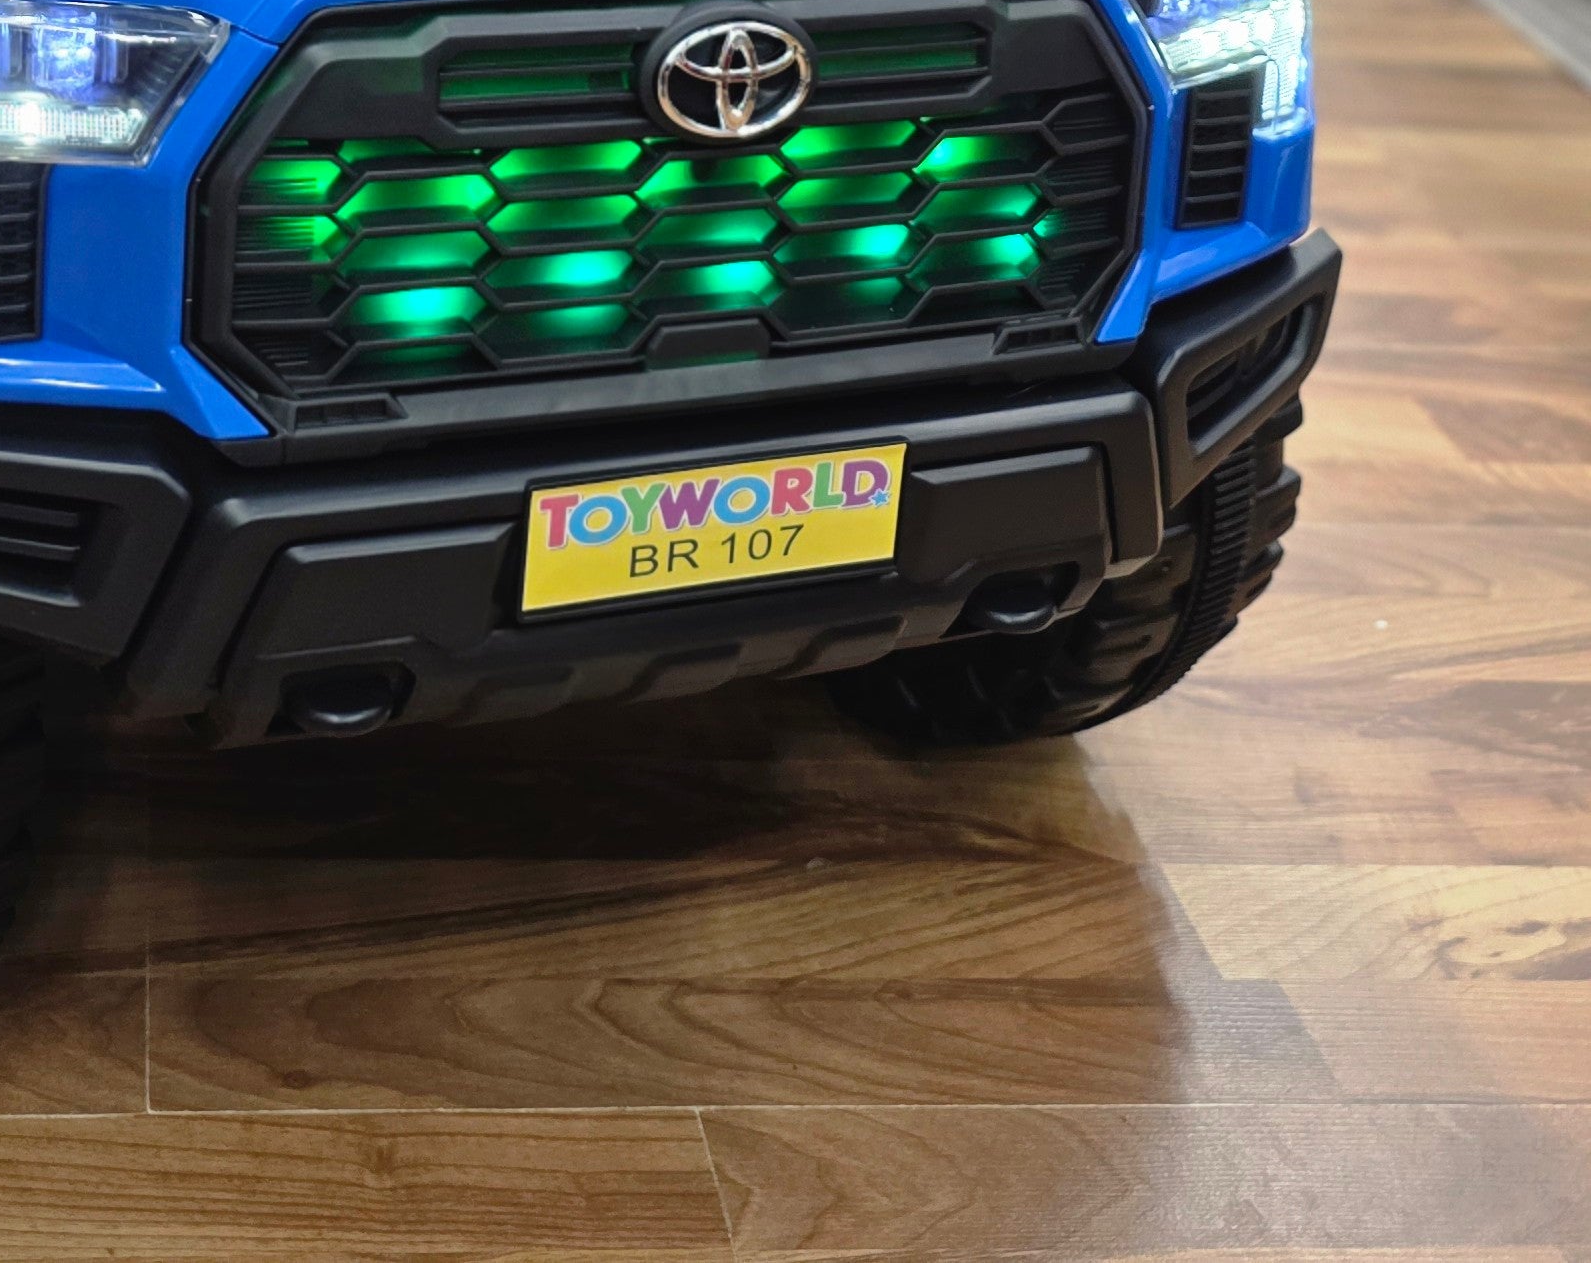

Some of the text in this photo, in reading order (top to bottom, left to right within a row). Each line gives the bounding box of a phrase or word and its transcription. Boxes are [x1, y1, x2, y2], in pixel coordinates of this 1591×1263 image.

[539, 460, 890, 549] TOYWORLD
[628, 524, 805, 579] BR 107
